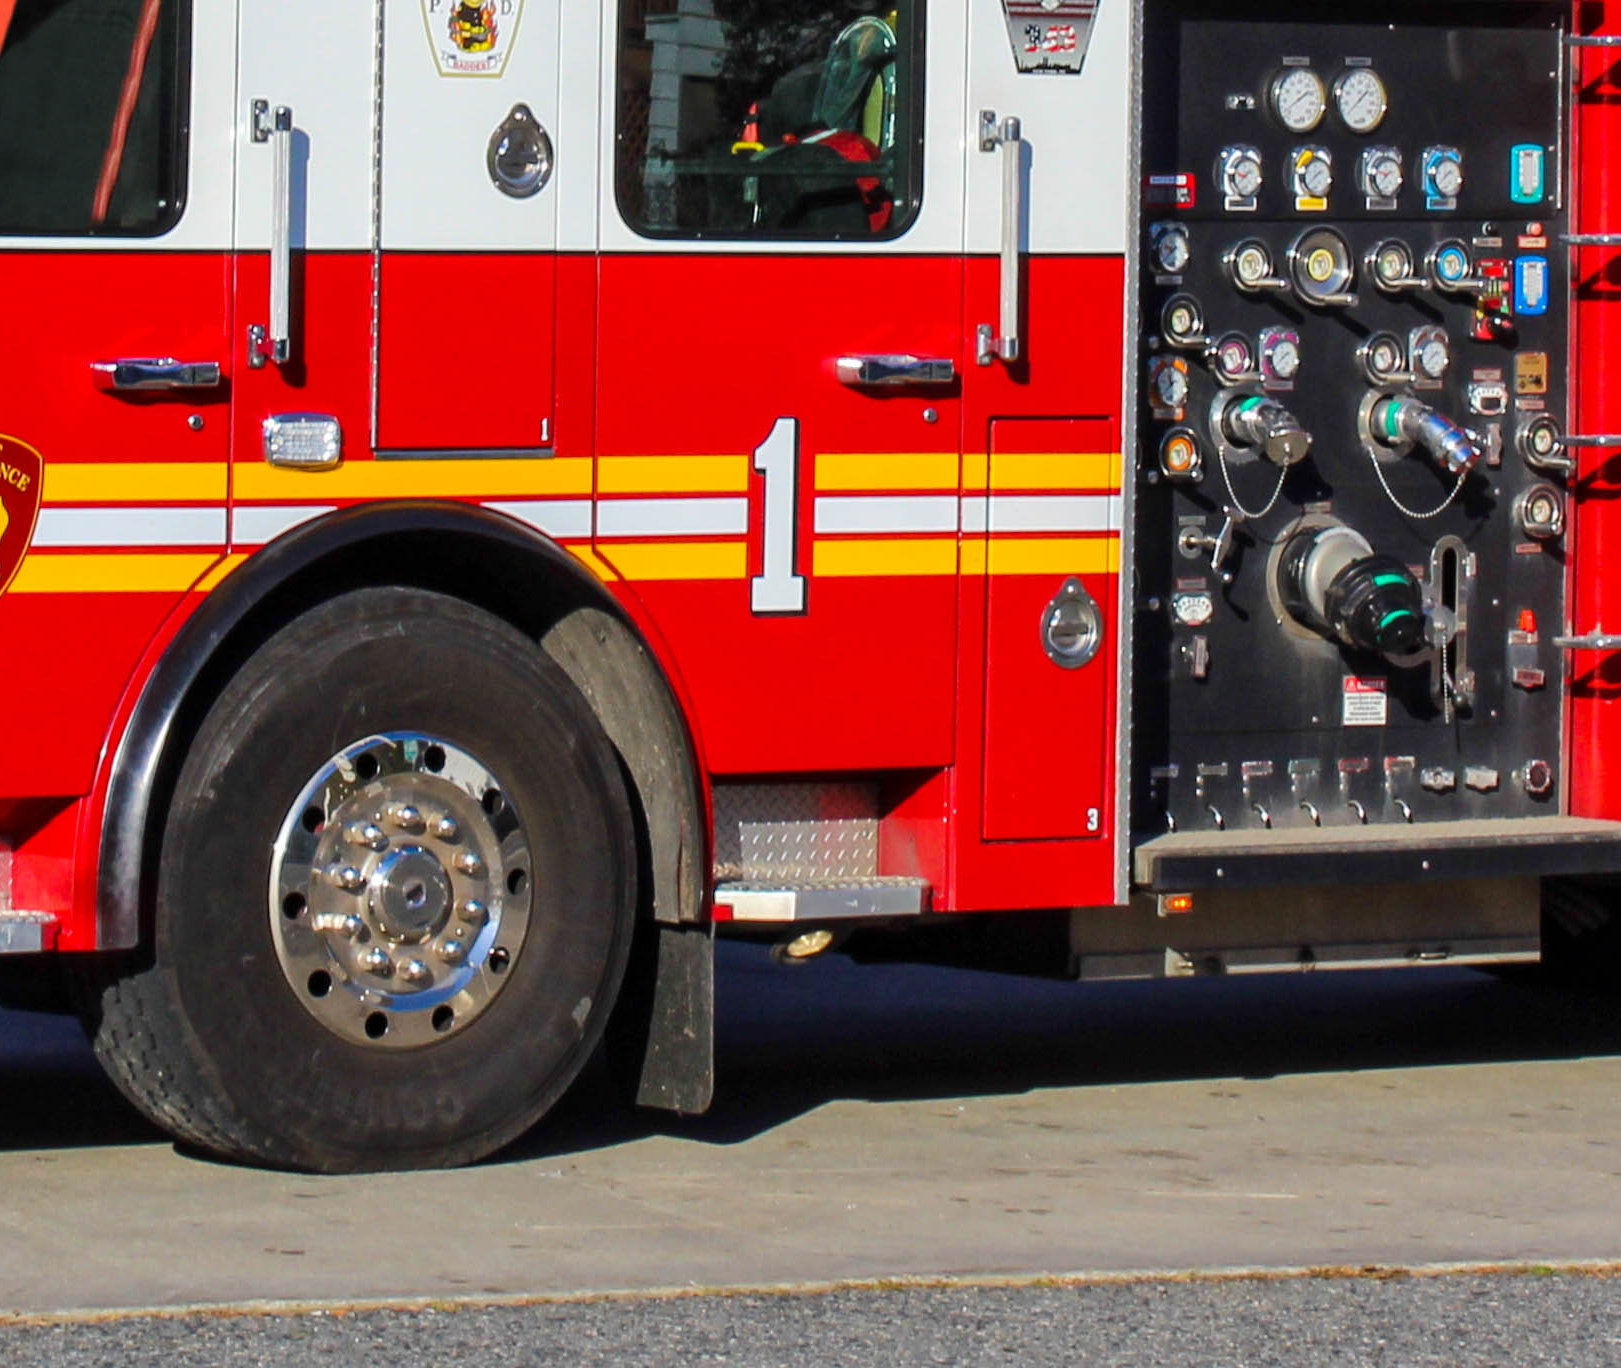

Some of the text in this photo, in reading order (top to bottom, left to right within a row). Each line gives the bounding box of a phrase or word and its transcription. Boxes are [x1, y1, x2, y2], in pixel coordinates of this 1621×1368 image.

[540, 417, 549, 442] 1
[751, 417, 805, 613] 1
[1086, 807, 1099, 831] 3
